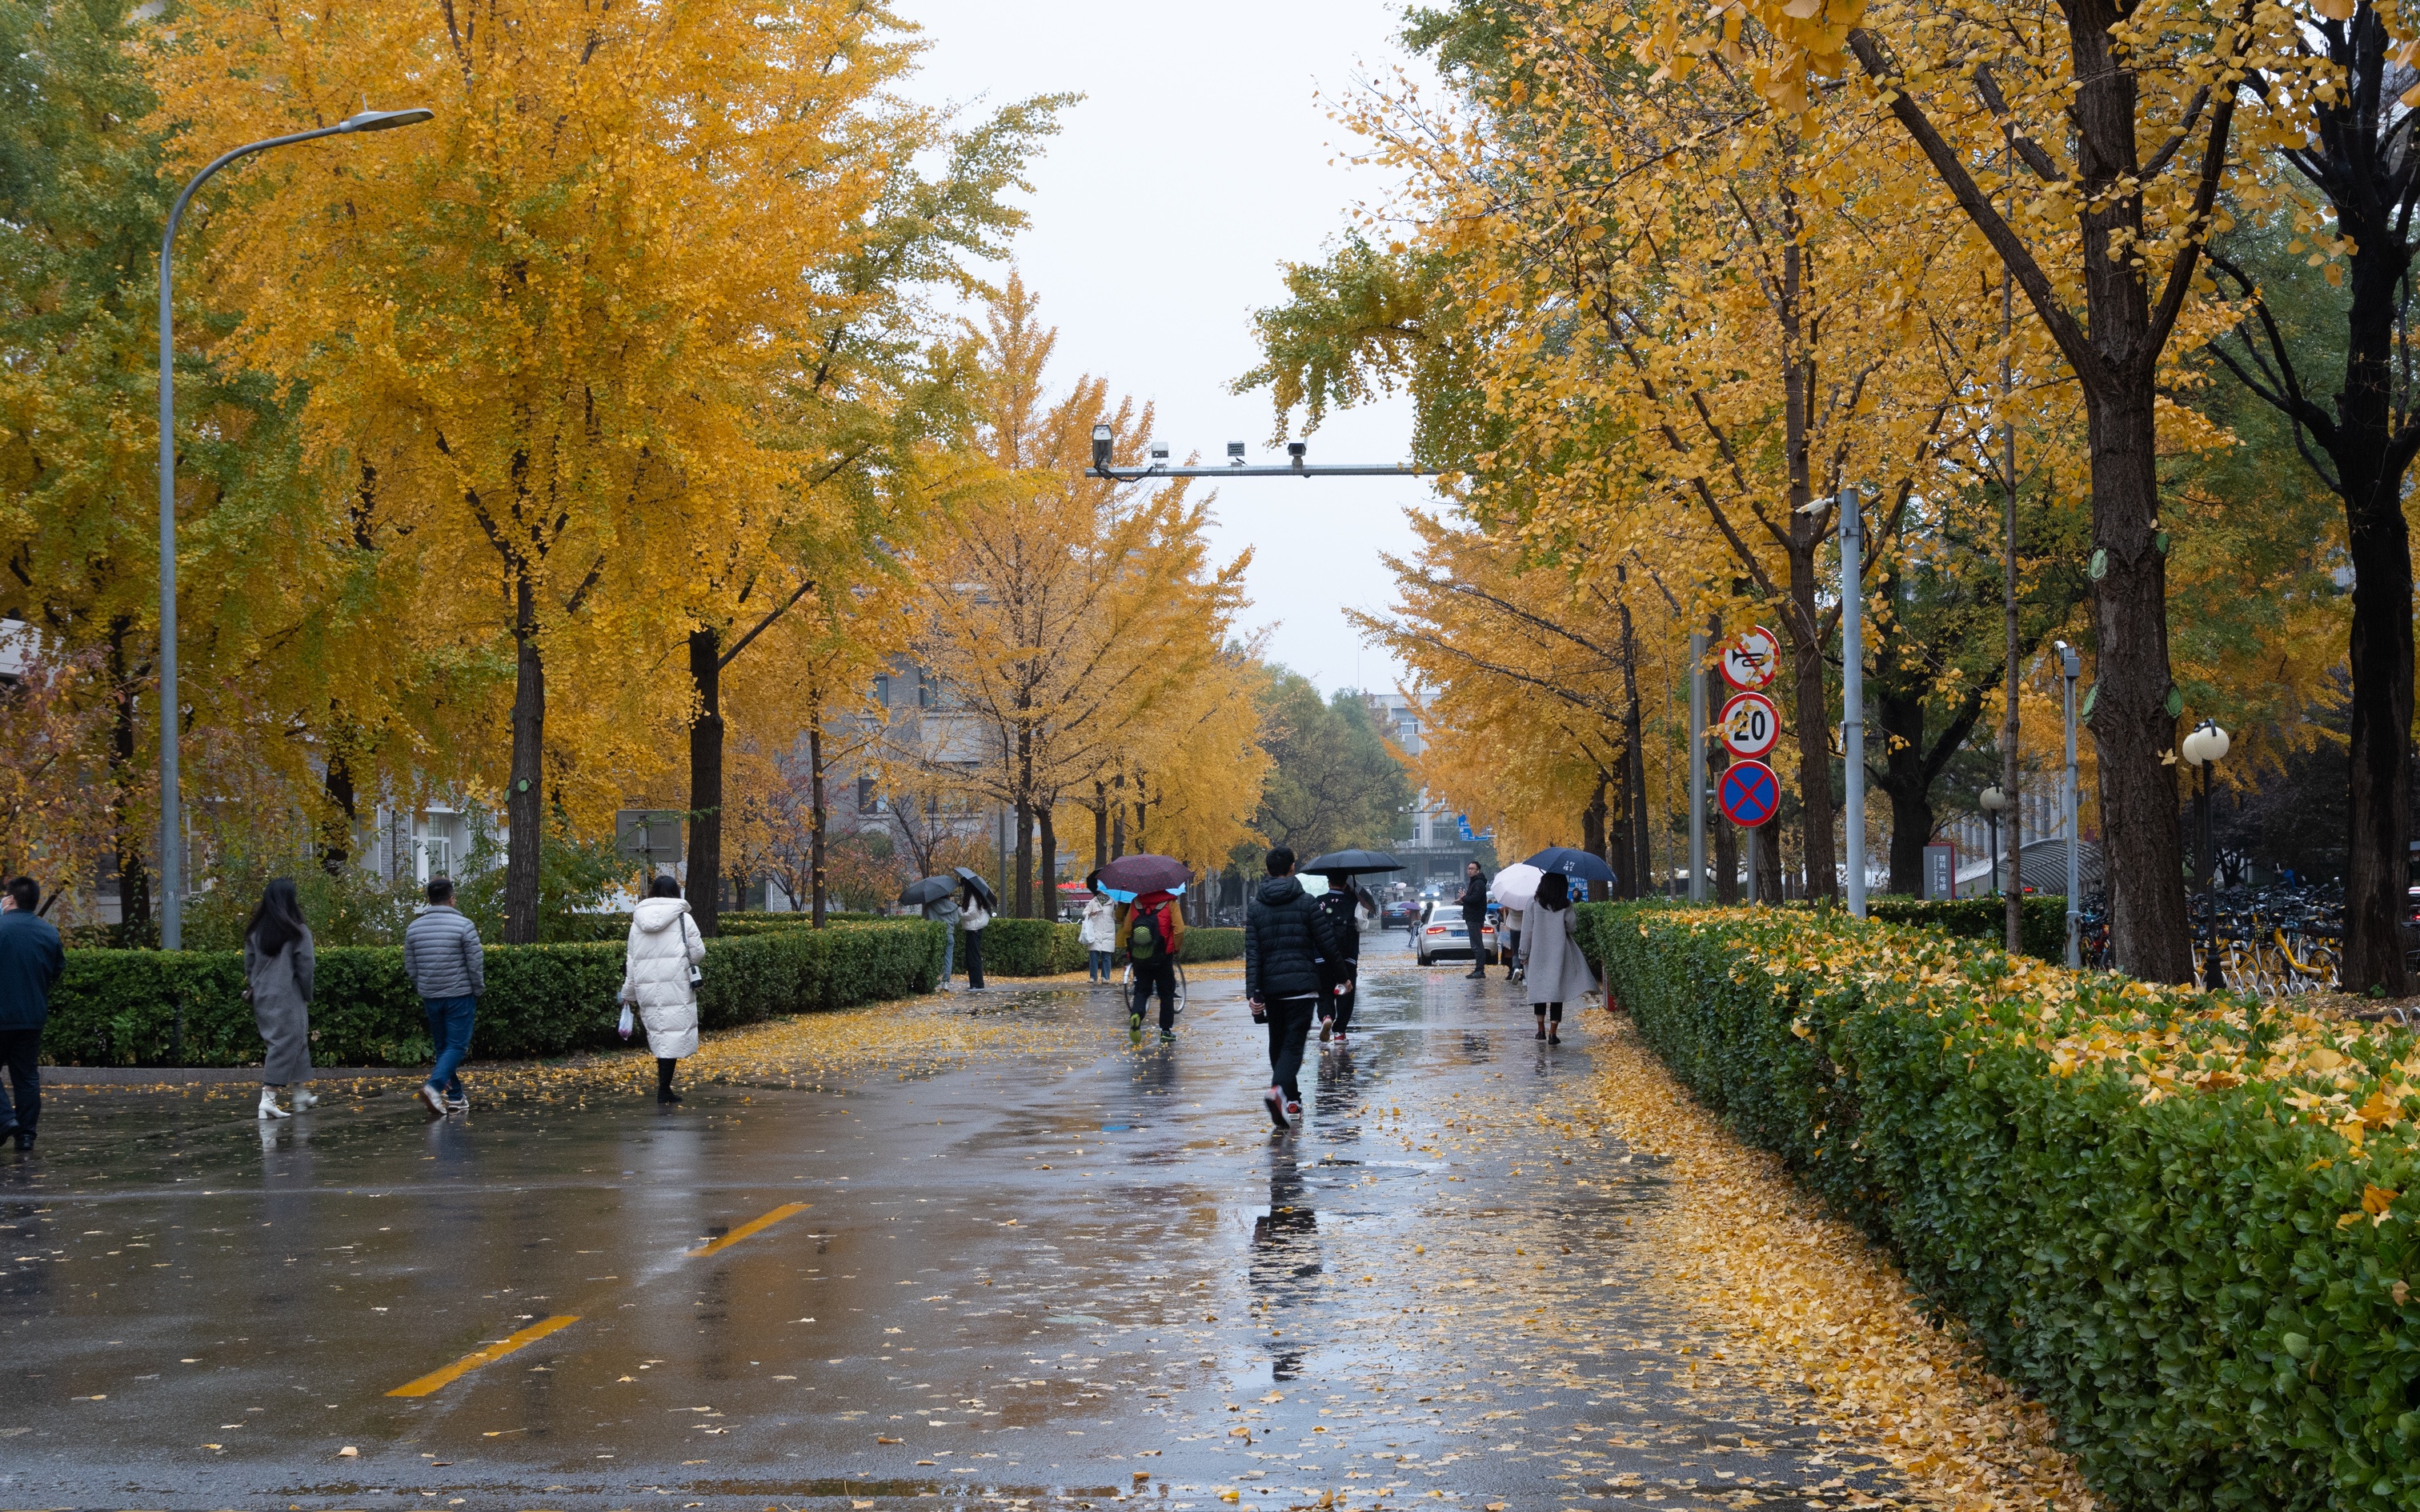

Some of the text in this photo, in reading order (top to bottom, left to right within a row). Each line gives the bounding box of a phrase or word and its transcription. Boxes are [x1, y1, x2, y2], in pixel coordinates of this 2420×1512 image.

[1734, 710, 1765, 741] 20
[1938, 854, 1946, 891] 理科一号楼
